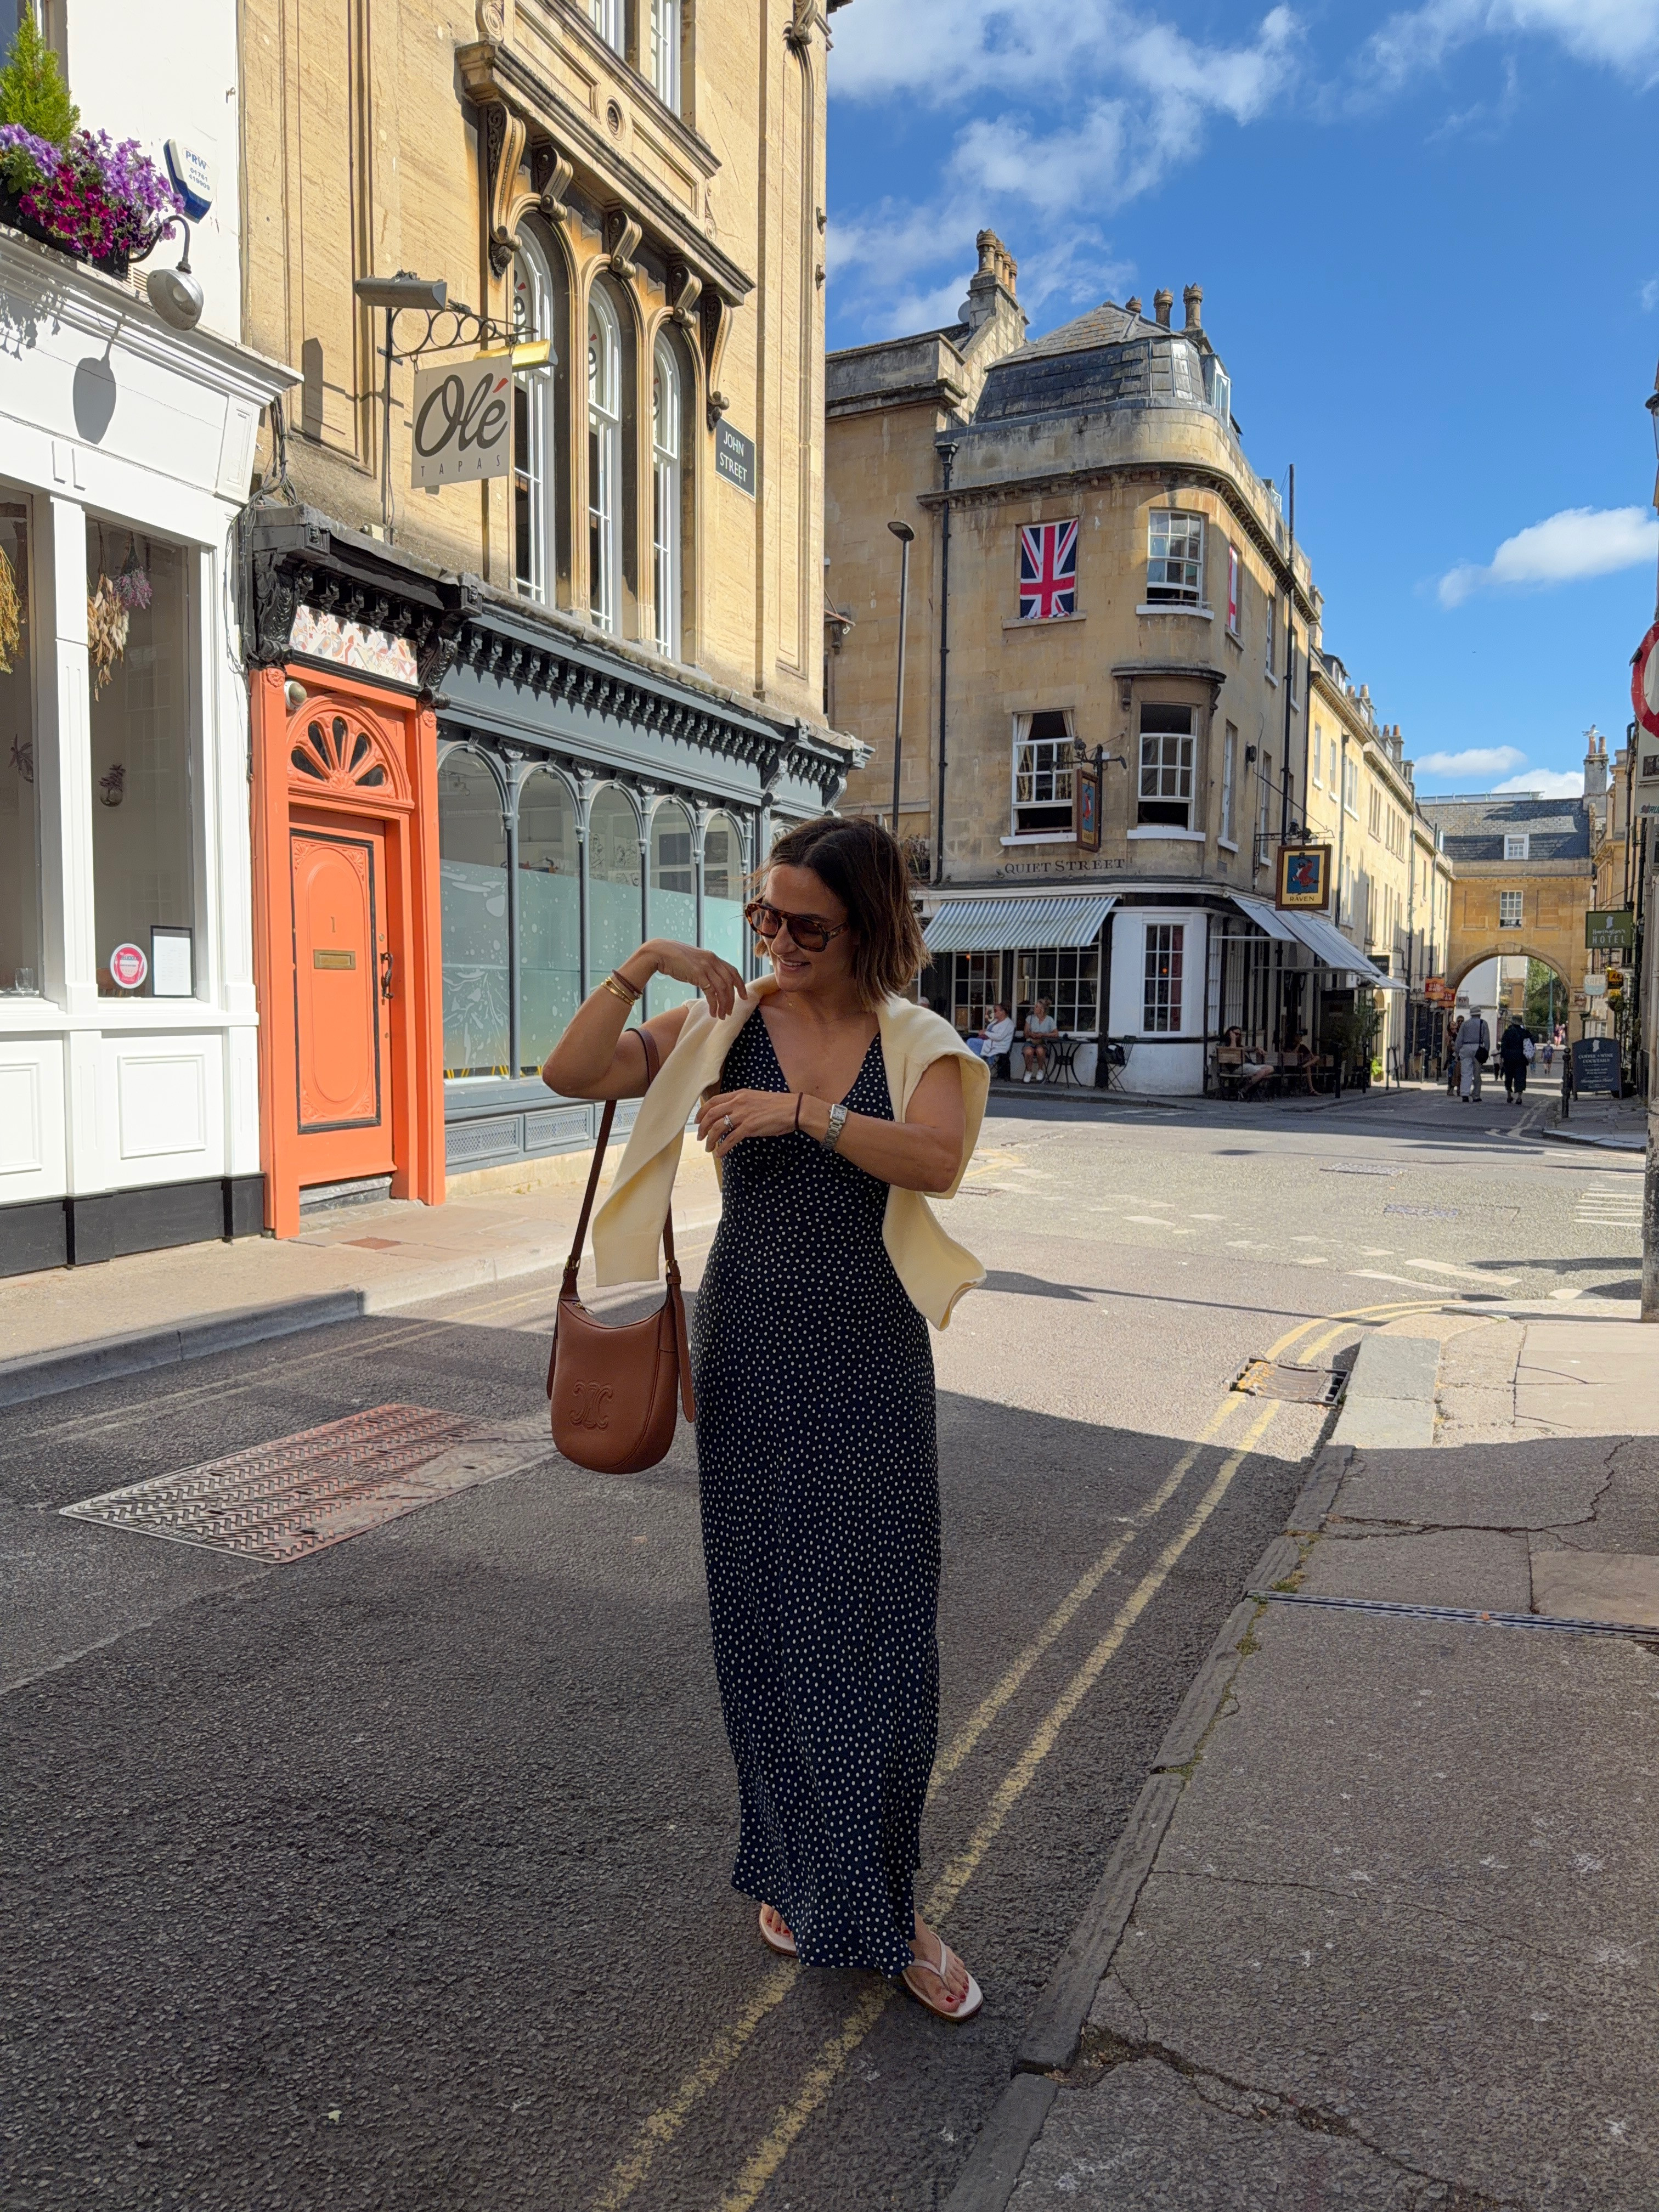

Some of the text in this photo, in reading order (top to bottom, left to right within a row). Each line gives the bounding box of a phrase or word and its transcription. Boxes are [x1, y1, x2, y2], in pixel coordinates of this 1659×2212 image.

[185, 150, 207, 170] PRW
[188, 174, 210, 191] 419909
[190, 167, 208, 182] 01761
[415, 373, 509, 457] Olé
[723, 431, 744, 458] JOHN
[420, 454, 500, 477] TAPAS
[719, 452, 748, 482] STREET
[1005, 859, 1125, 874] QUIET STREET
[330, 916, 336, 933] 1
[1592, 935, 1625, 944] HOTEL
